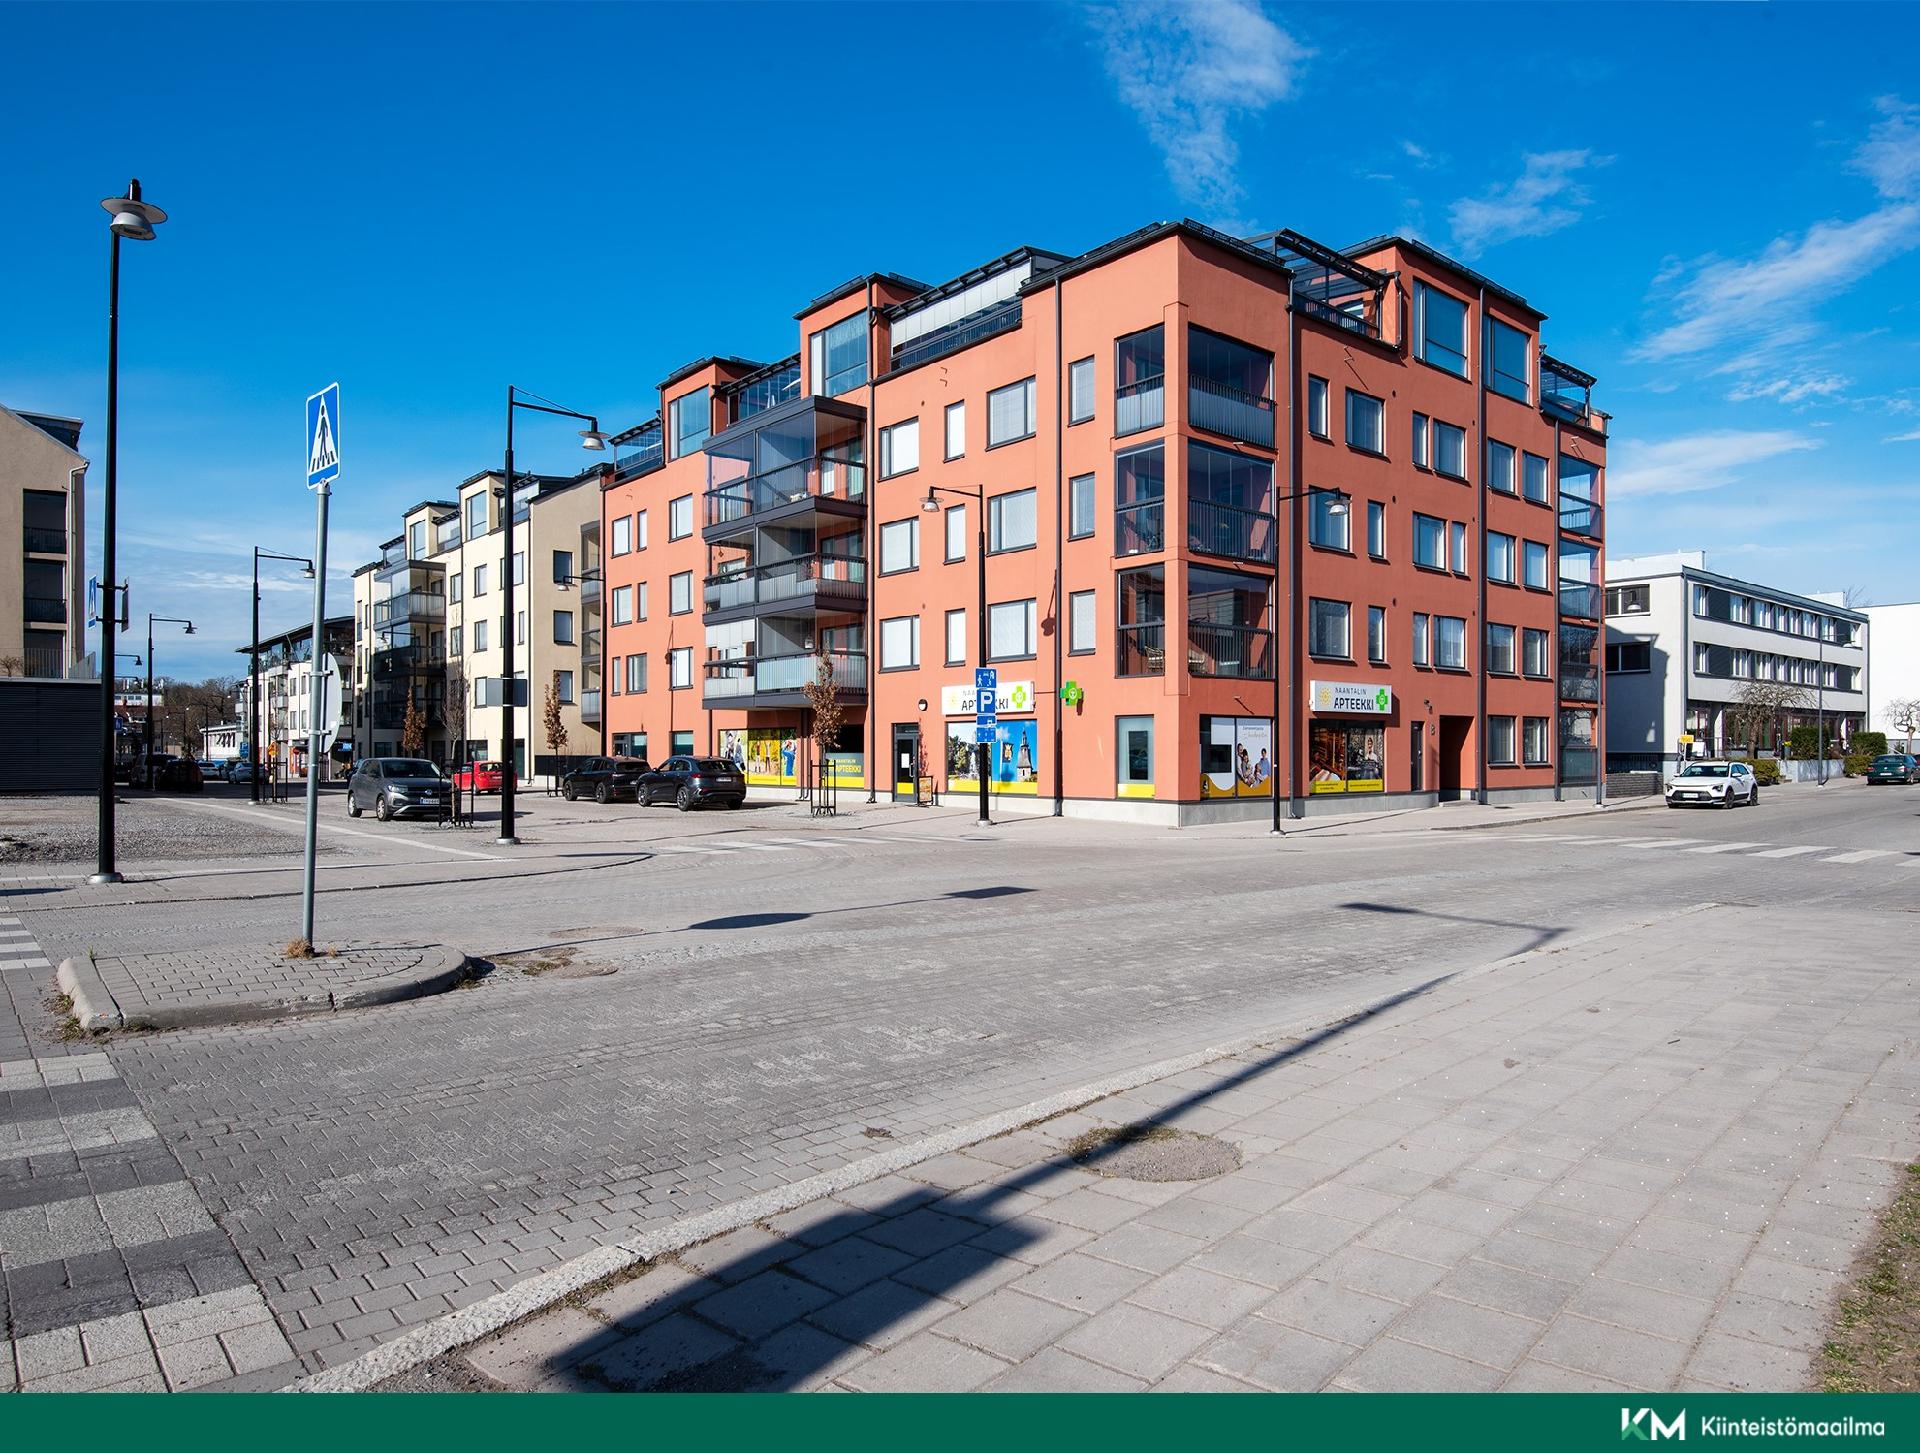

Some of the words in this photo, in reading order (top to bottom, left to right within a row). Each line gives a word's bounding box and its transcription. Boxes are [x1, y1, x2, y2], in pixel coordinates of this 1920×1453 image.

[1335, 687, 1367, 695] NAANTALIN
[980, 691, 993, 712] P
[1334, 697, 1374, 711] APTEEKKI
